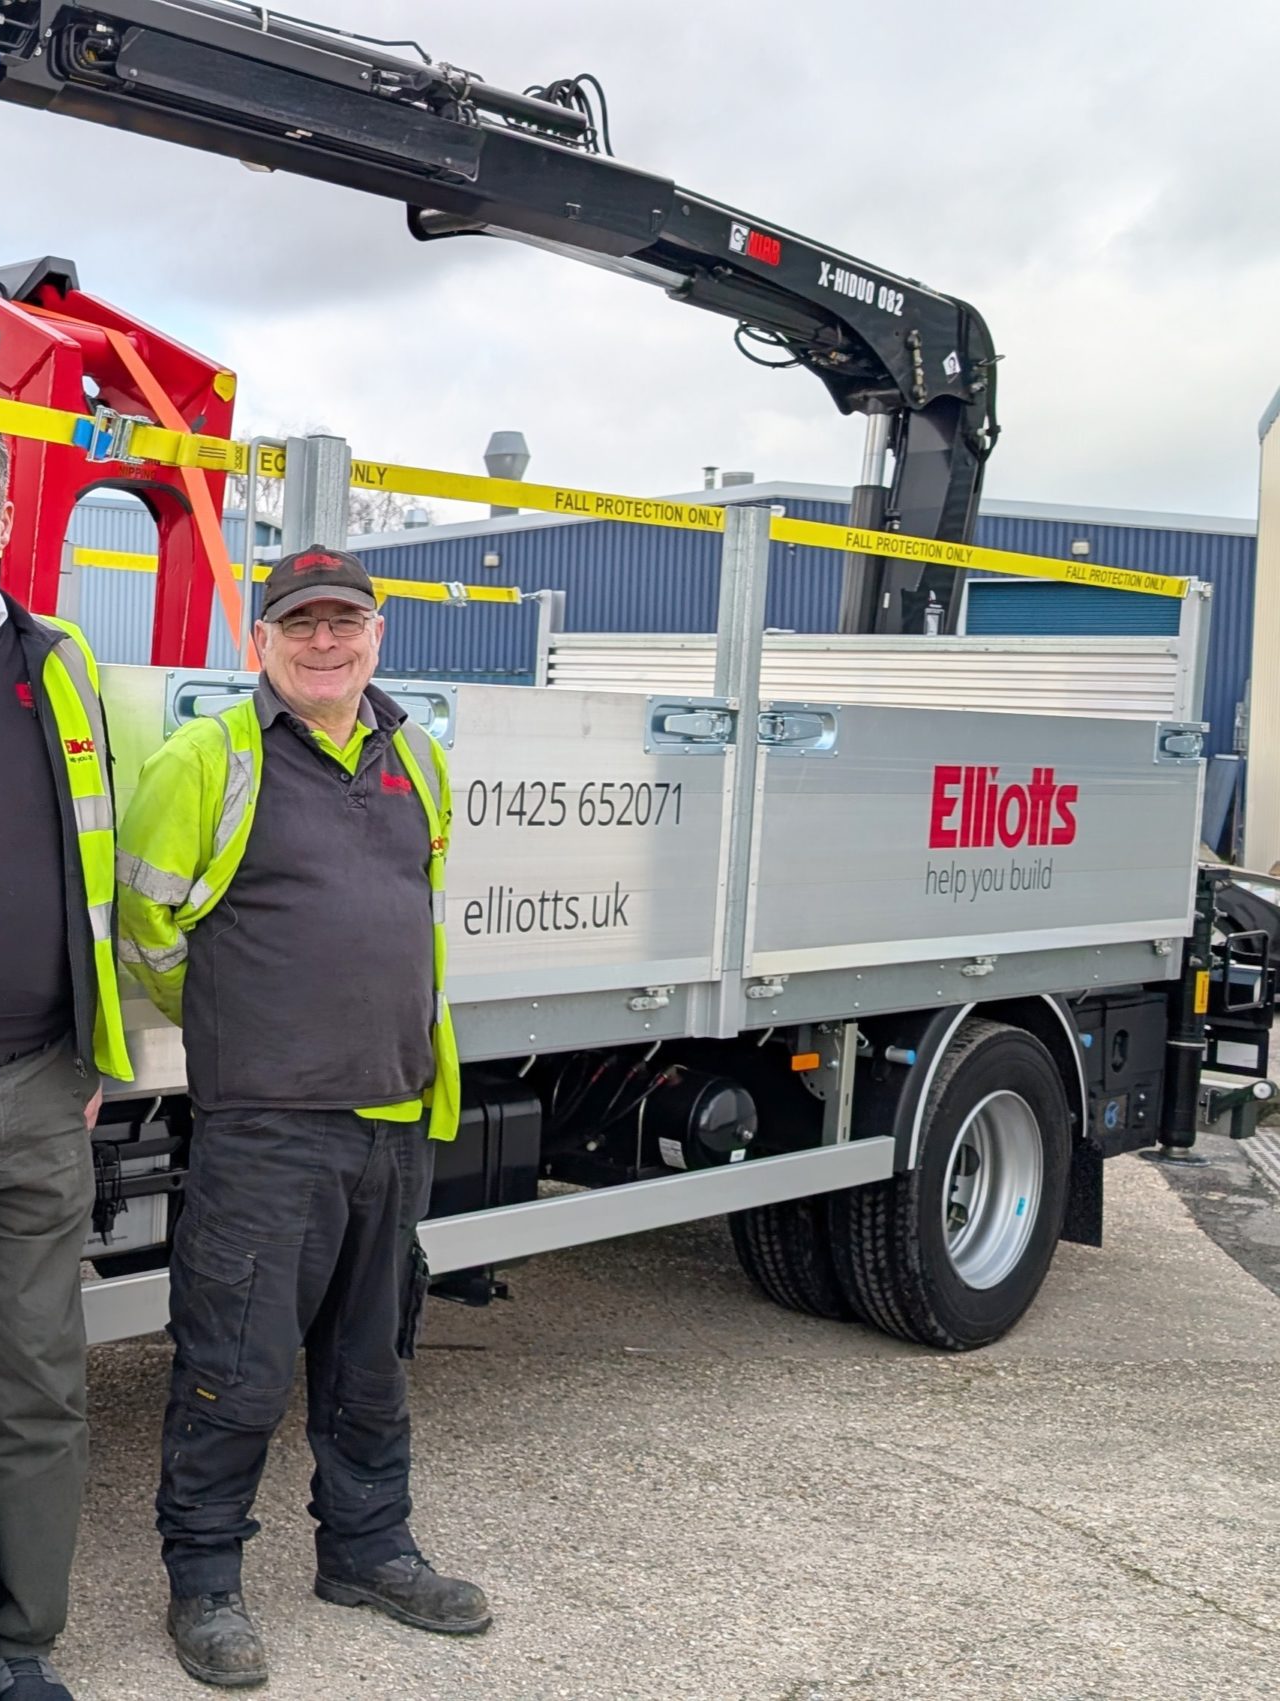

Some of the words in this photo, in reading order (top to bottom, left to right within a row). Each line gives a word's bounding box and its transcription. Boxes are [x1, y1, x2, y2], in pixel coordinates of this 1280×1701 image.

[747, 230, 781, 267] HIAB
[818, 260, 875, 305] X-HIDUO
[877, 285, 906, 317] 082
[554, 491, 590, 512] FALL
[595, 497, 683, 522] PROTECTION
[688, 507, 723, 528] ONLY
[845, 532, 873, 550] FALL
[876, 536, 942, 559] PROTECTION
[945, 546, 973, 564] ONLY
[1065, 565, 1086, 581] FALL
[1088, 568, 1142, 589] PROTECTION
[1144, 576, 1167, 591] ONLY
[467, 779, 567, 826] 01425
[578, 781, 682, 826] 652071
[928, 765, 1079, 849] Elliotts
[925, 860, 967, 903] help
[970, 866, 1005, 903] you
[1010, 857, 1053, 892] build
[463, 881, 629, 936] elliotts.uk
